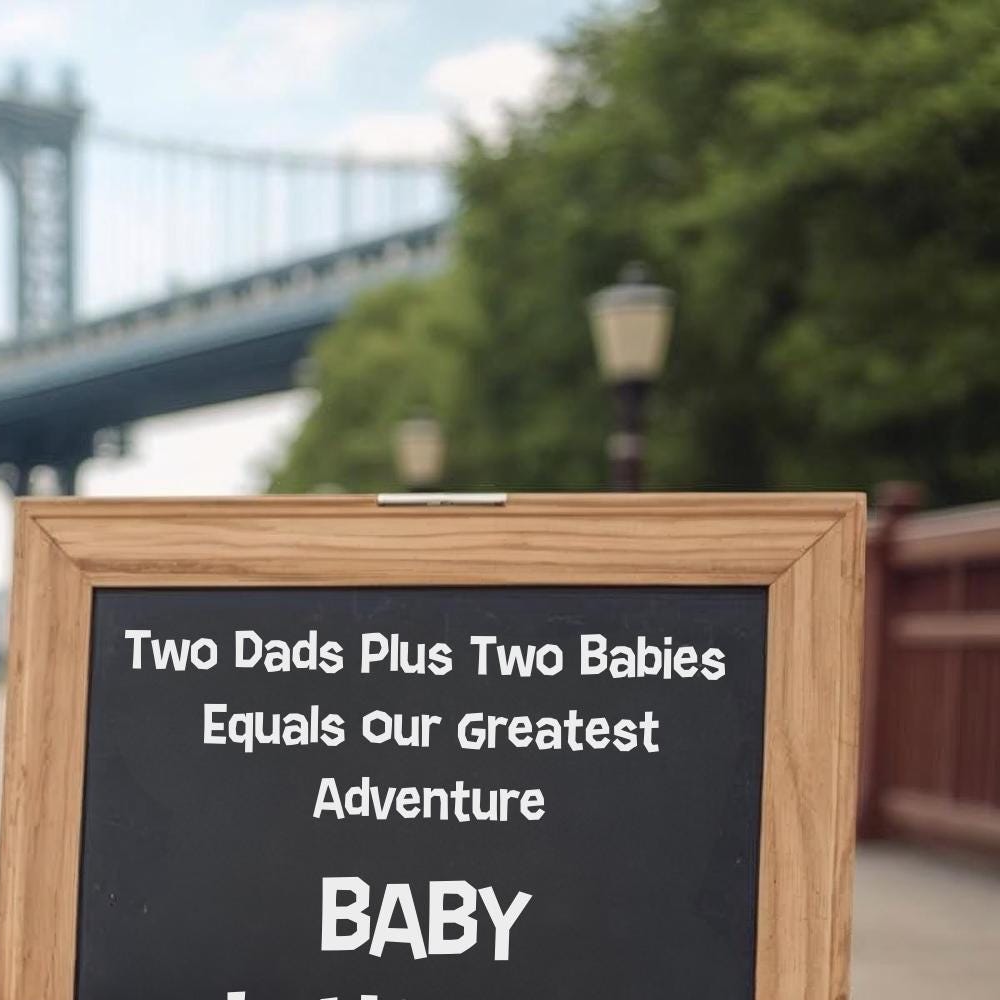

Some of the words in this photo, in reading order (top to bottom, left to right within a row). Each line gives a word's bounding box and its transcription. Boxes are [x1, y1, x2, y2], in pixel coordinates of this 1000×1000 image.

[125, 630, 217, 671] Two
[236, 630, 343, 673] Dads
[361, 633, 452, 675] Plus
[470, 636, 563, 677] Two
[581, 634, 725, 680] Babies
[204, 704, 345, 752] Equals
[458, 710, 659, 752] Greatest
[313, 777, 545, 822] Adventure
[321, 877, 532, 960] BABY
